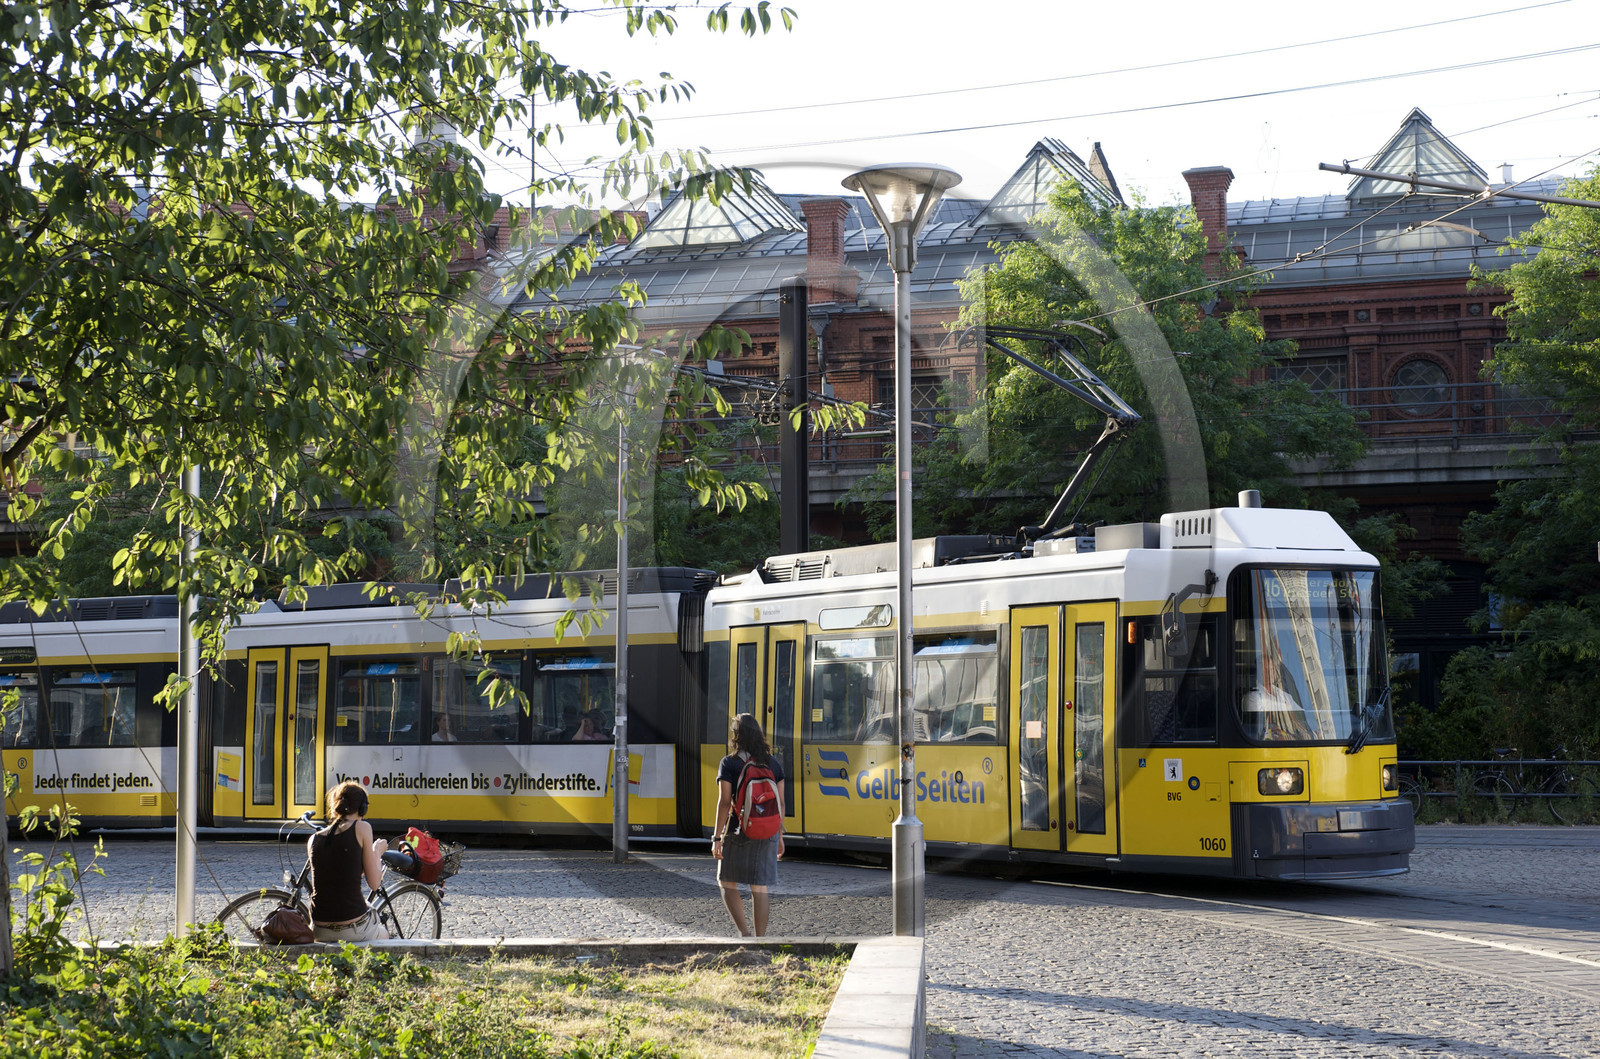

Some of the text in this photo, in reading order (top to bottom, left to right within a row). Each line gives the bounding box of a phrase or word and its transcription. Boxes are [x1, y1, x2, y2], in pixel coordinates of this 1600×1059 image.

[1264, 577, 1281, 598] 16
[34, 774, 69, 789] Jeder
[71, 773, 111, 789] findet
[111, 772, 153, 792] jeden.
[372, 772, 468, 789] Aalräuchereien
[471, 773, 490, 790] bis
[503, 773, 601, 795] Zylinderstifte.
[856, 768, 985, 804] Gelb Seiten
[1167, 792, 1182, 801] BVG
[1199, 837, 1226, 851] 1060
